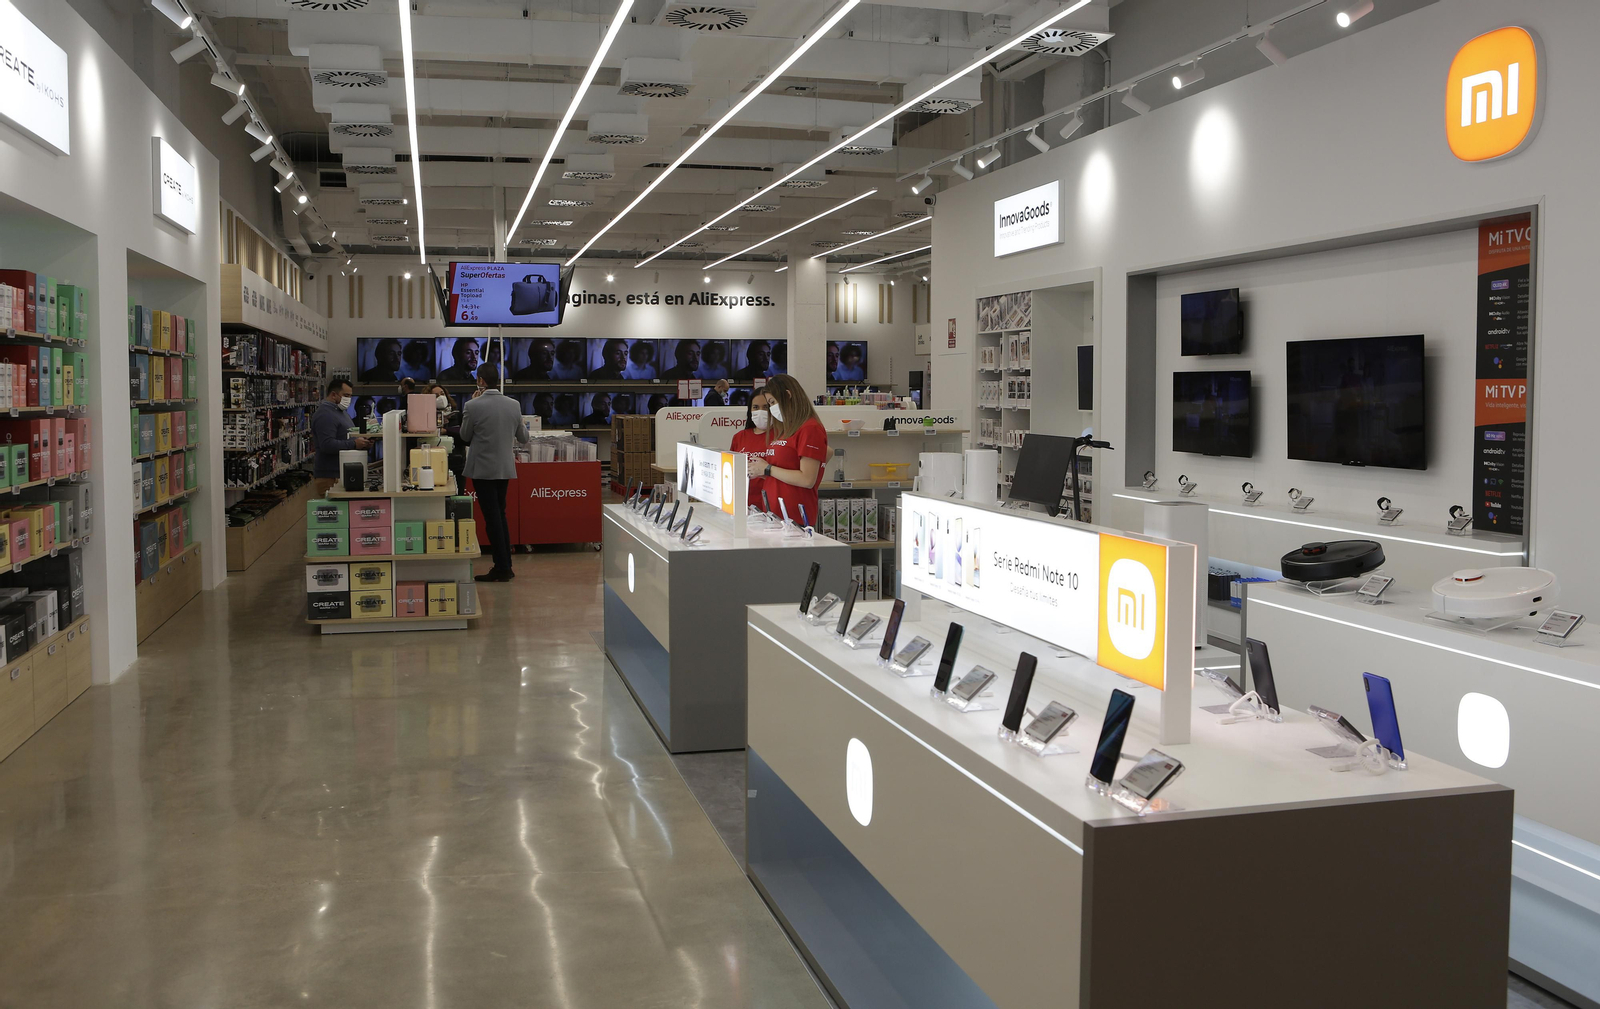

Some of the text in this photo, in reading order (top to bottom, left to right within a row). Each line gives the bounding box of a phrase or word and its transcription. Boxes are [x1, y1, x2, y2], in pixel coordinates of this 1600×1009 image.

[163, 172, 182, 196] CREATE
[999, 200, 1050, 229] InnovaGoods
[1488, 230, 1503, 247] Mi
[1505, 227, 1524, 244] TV
[460, 271, 506, 279] SuperOfertas
[626, 291, 660, 306] está
[664, 293, 685, 306] en
[688, 291, 776, 310] AliExpress.
[1485, 385, 1499, 398] Mi
[1500, 385, 1517, 399] TV
[530, 487, 588, 501] AliExpress
[1484, 490, 1502, 498] NETFLIX
[993, 551, 1079, 591] Serie Redmi Note 10
